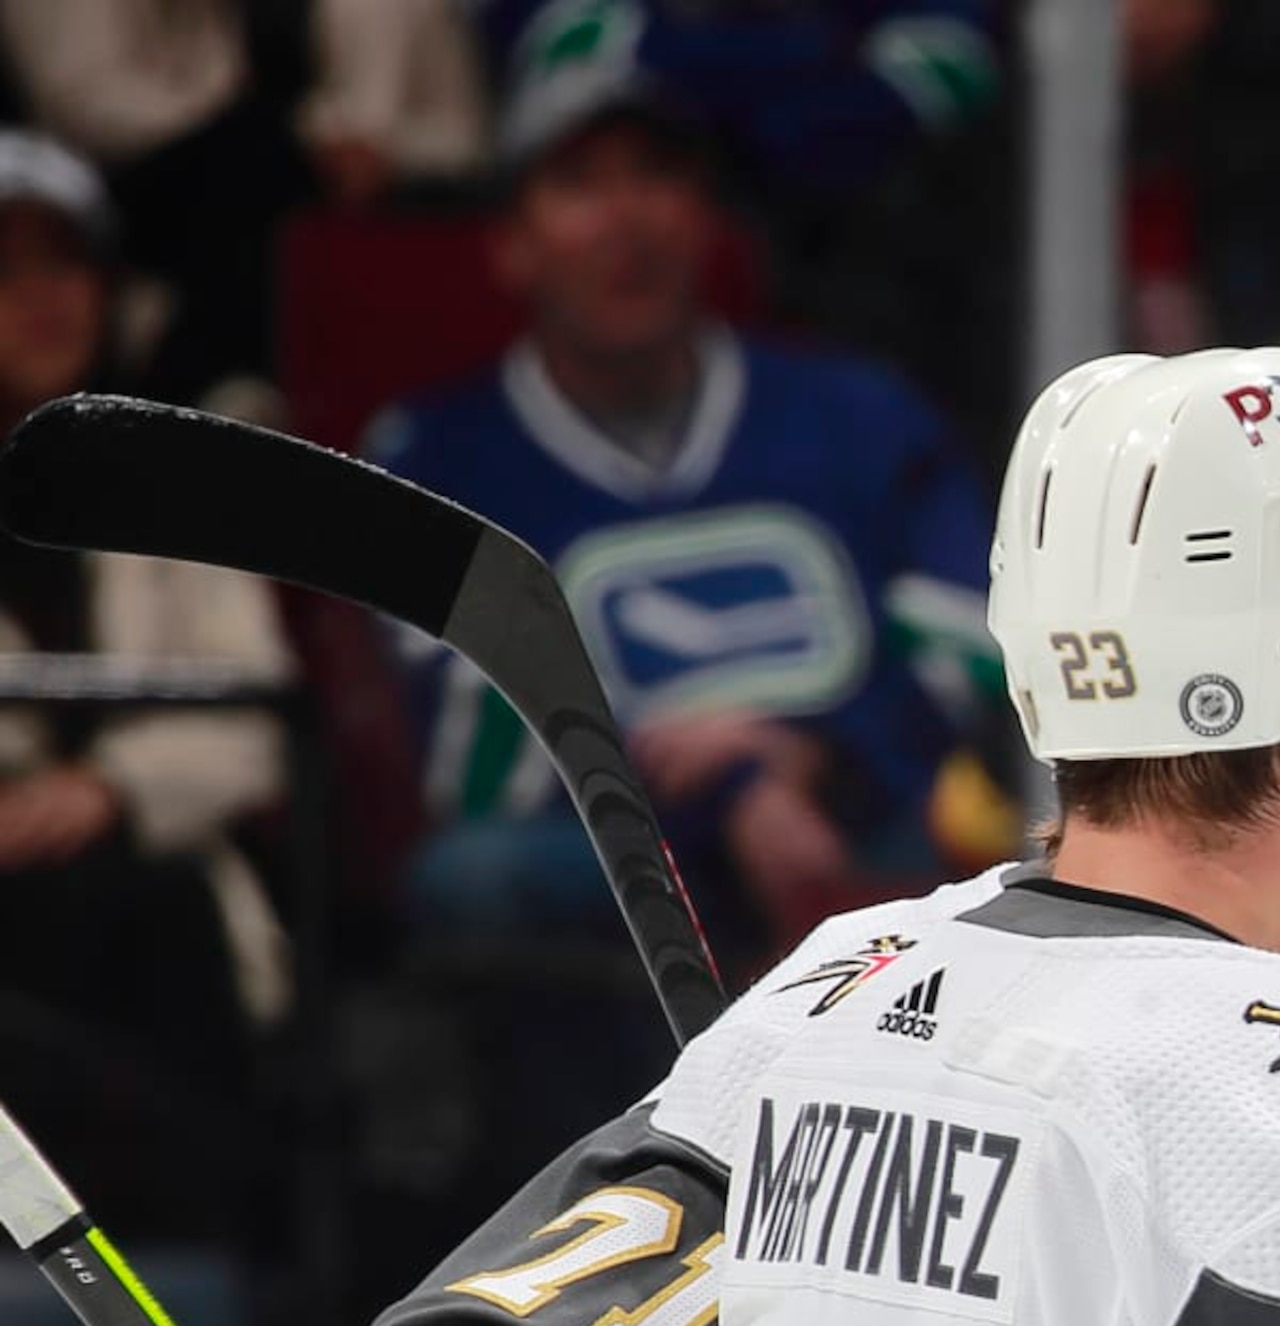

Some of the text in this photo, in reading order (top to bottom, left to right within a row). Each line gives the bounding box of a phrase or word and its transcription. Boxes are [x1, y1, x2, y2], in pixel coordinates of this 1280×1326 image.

[1049, 631, 1139, 700] 23
[876, 1009, 938, 1041] adidas
[734, 1096, 1022, 1302] MARTINEZ
